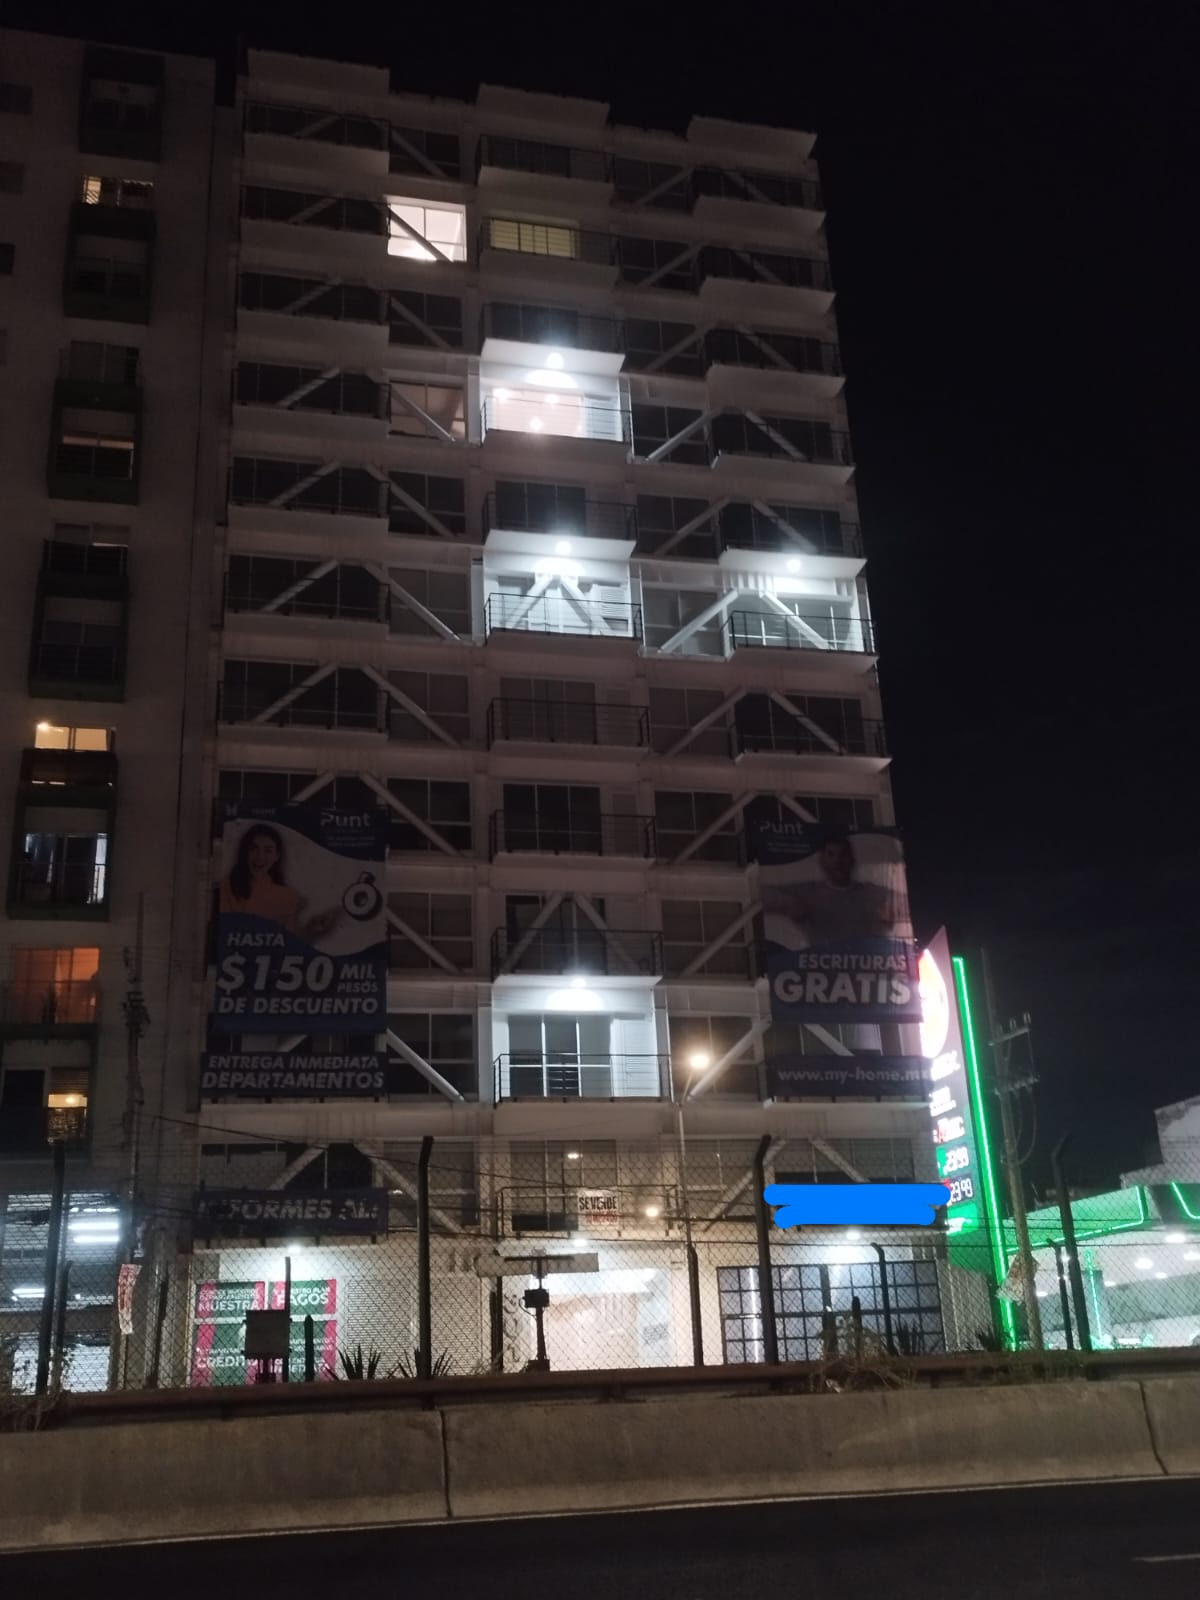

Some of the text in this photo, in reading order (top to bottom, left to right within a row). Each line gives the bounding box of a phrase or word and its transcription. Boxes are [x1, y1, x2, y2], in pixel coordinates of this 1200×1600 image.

[226, 932, 286, 948] HASTA
[798, 953, 907, 971] ESCRITURAS
[216, 951, 335, 996] $150
[339, 963, 377, 981] MIL
[336, 981, 379, 994] PESOS
[773, 969, 911, 1006] GRATIS
[217, 996, 379, 1016] DE DESCUENTO
[207, 1055, 381, 1070] ENTREGA INMEDIATA
[201, 1070, 386, 1089] DEPARTAMENTOS
